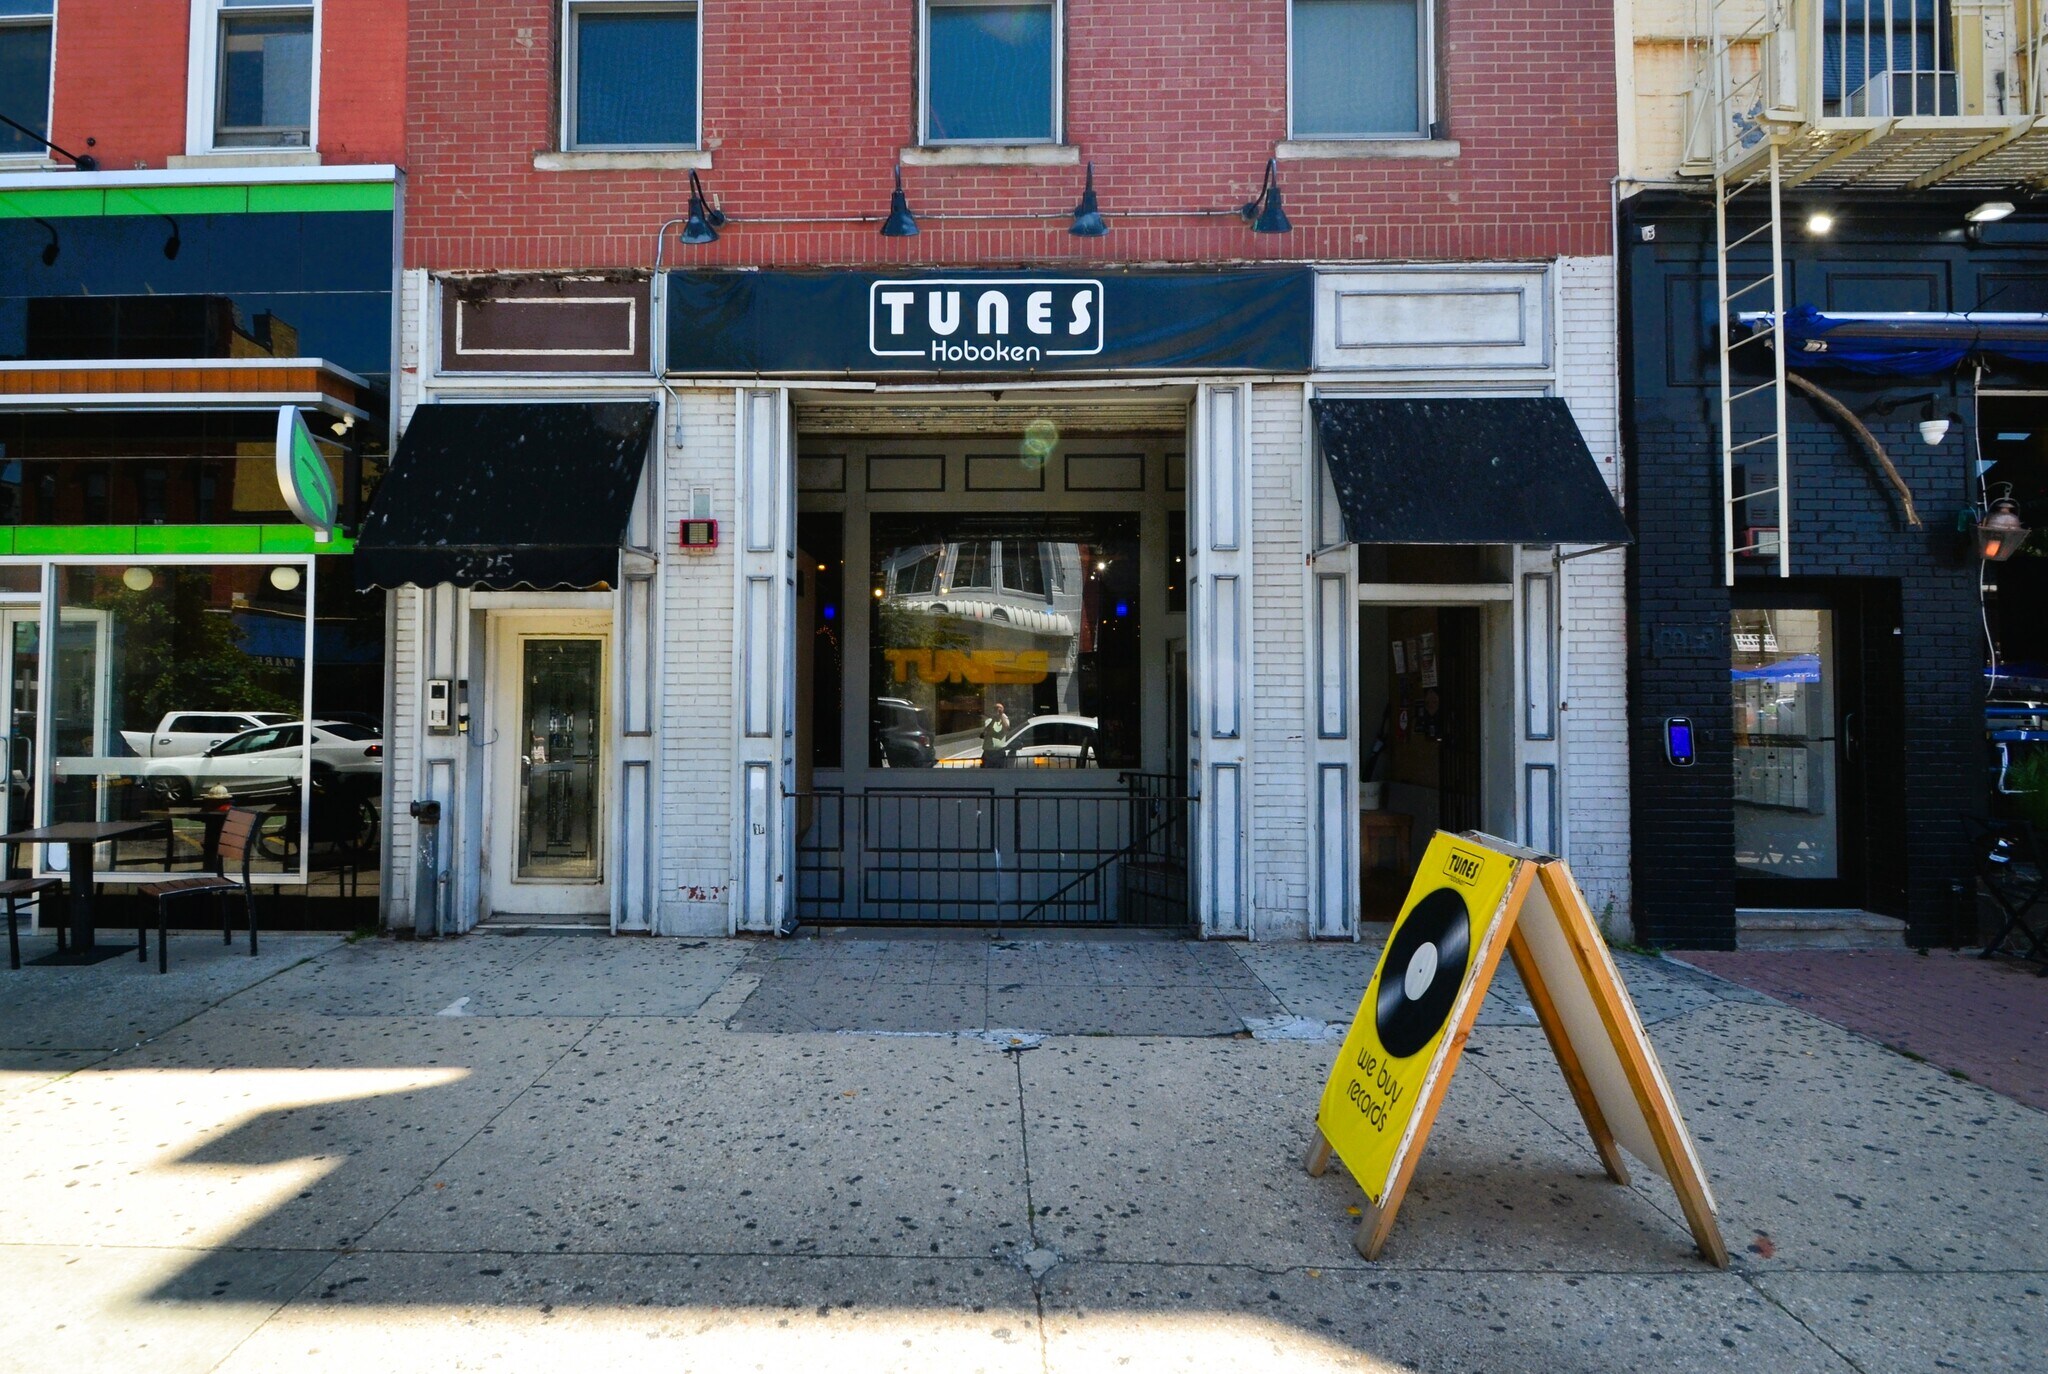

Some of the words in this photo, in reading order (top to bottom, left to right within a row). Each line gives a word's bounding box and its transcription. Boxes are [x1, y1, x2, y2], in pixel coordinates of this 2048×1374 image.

[881, 290, 1092, 335] TUNES
[931, 340, 1040, 361] Hoboken
[456, 553, 514, 578] 225
[884, 648, 1049, 684] TUNES
[1449, 854, 1479, 879] TUNES
[1357, 1047, 1377, 1077] we
[1377, 1058, 1404, 1111] buy
[1346, 1079, 1387, 1132] records
